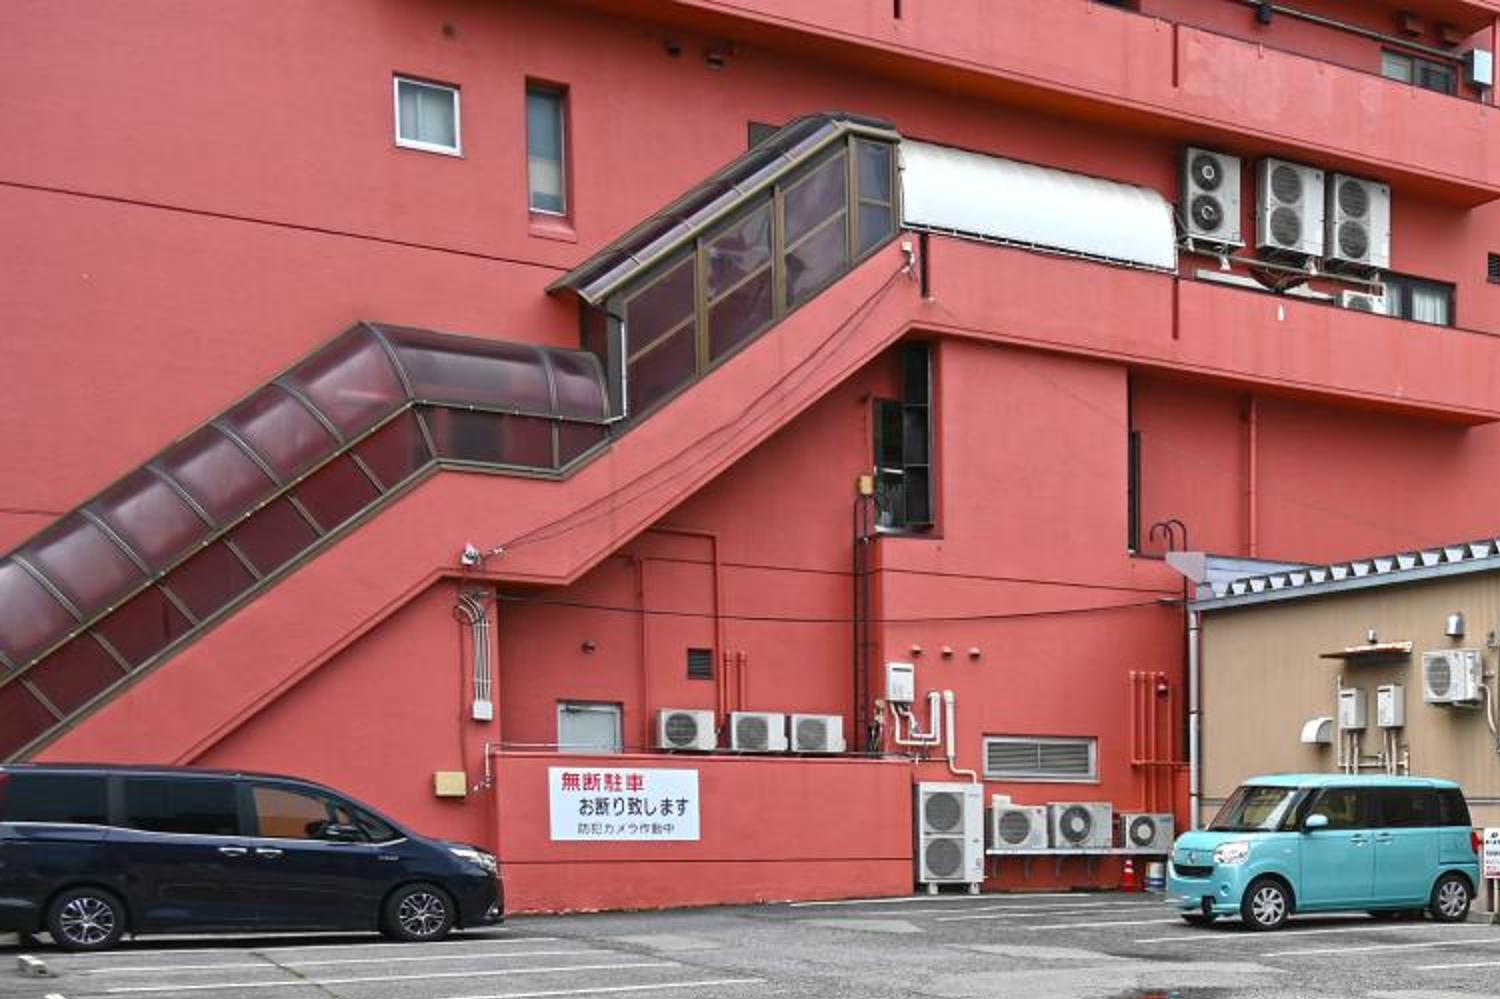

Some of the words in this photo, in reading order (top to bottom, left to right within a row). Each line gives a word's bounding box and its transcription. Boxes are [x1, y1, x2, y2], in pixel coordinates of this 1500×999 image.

[561, 773, 645, 792] 無断駐車
[579, 796, 688, 817] お断り致します
[578, 823, 675, 836] 防犯カメラ作動中
